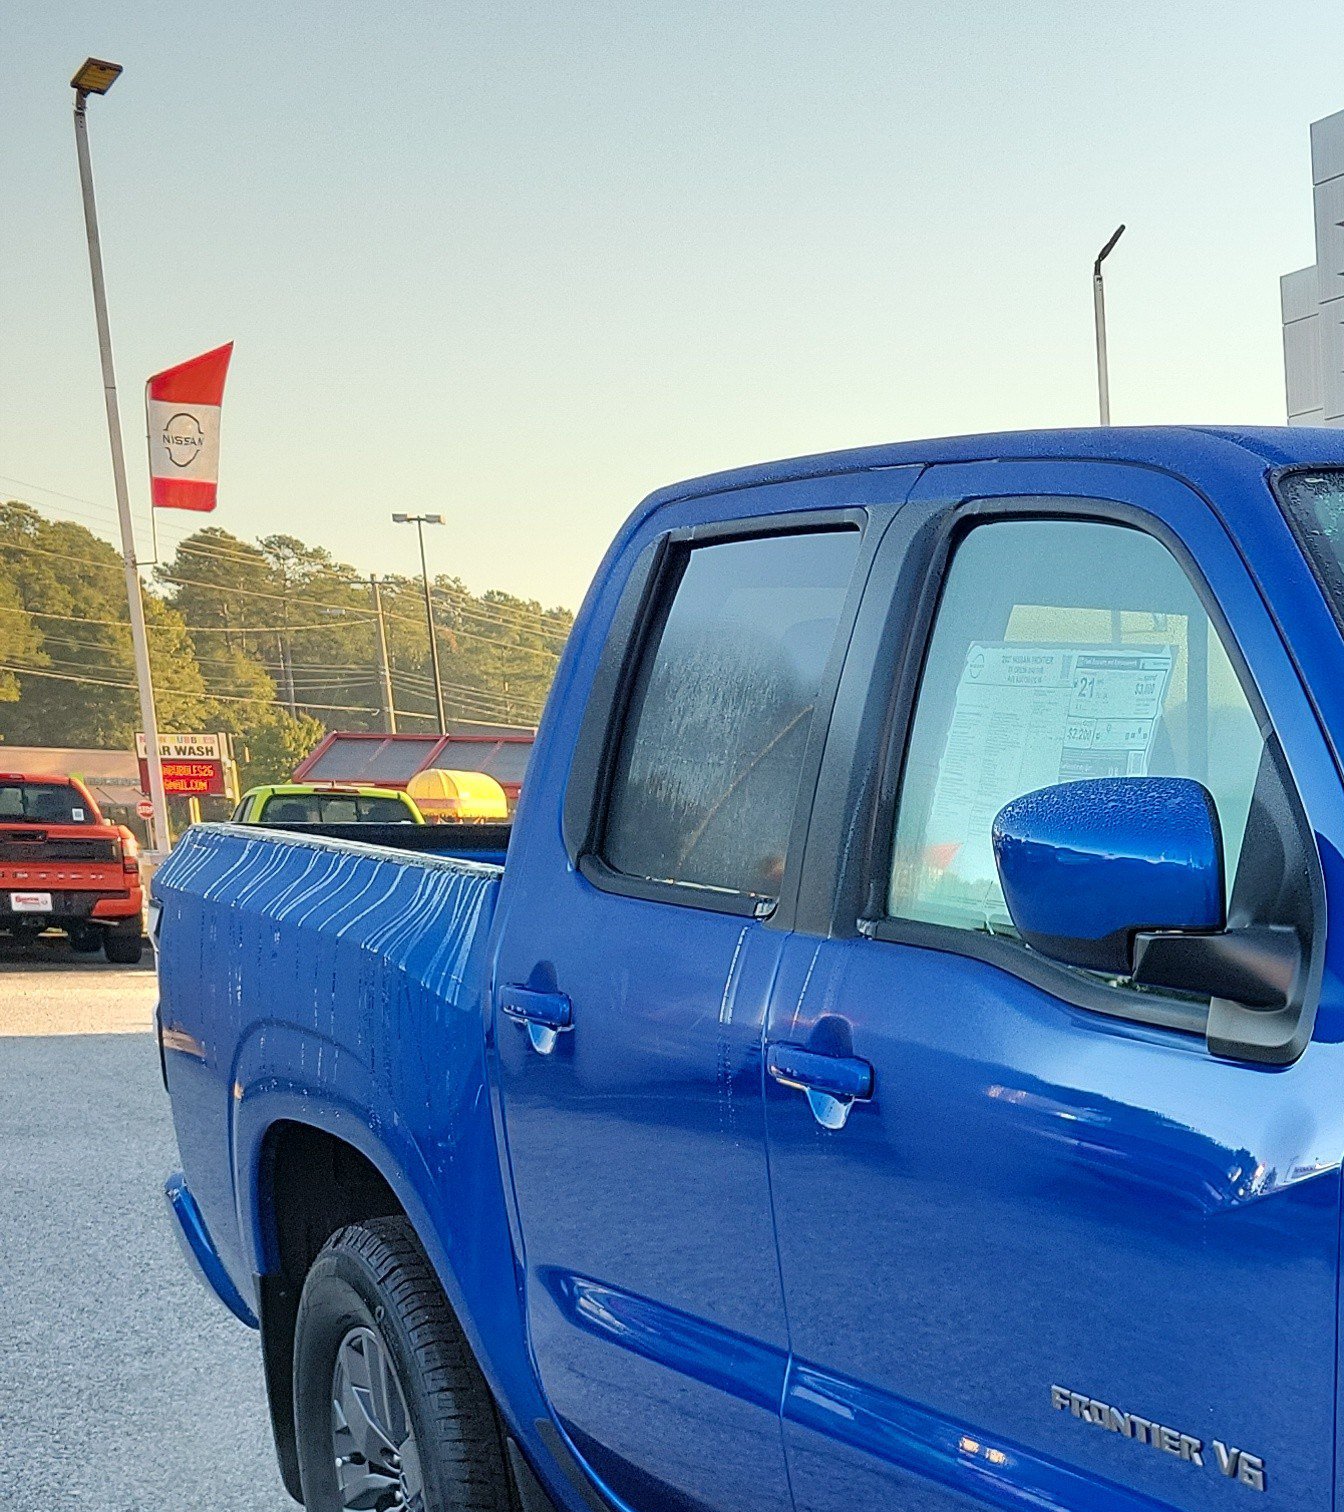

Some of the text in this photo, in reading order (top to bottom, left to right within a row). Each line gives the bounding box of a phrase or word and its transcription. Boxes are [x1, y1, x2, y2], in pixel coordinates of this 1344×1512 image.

[162, 434, 204, 446] NISSAN
[1077, 676, 1095, 698] 21
[174, 745, 214, 757] WASH
[1051, 1383, 1266, 1492] FRONTIER V6
